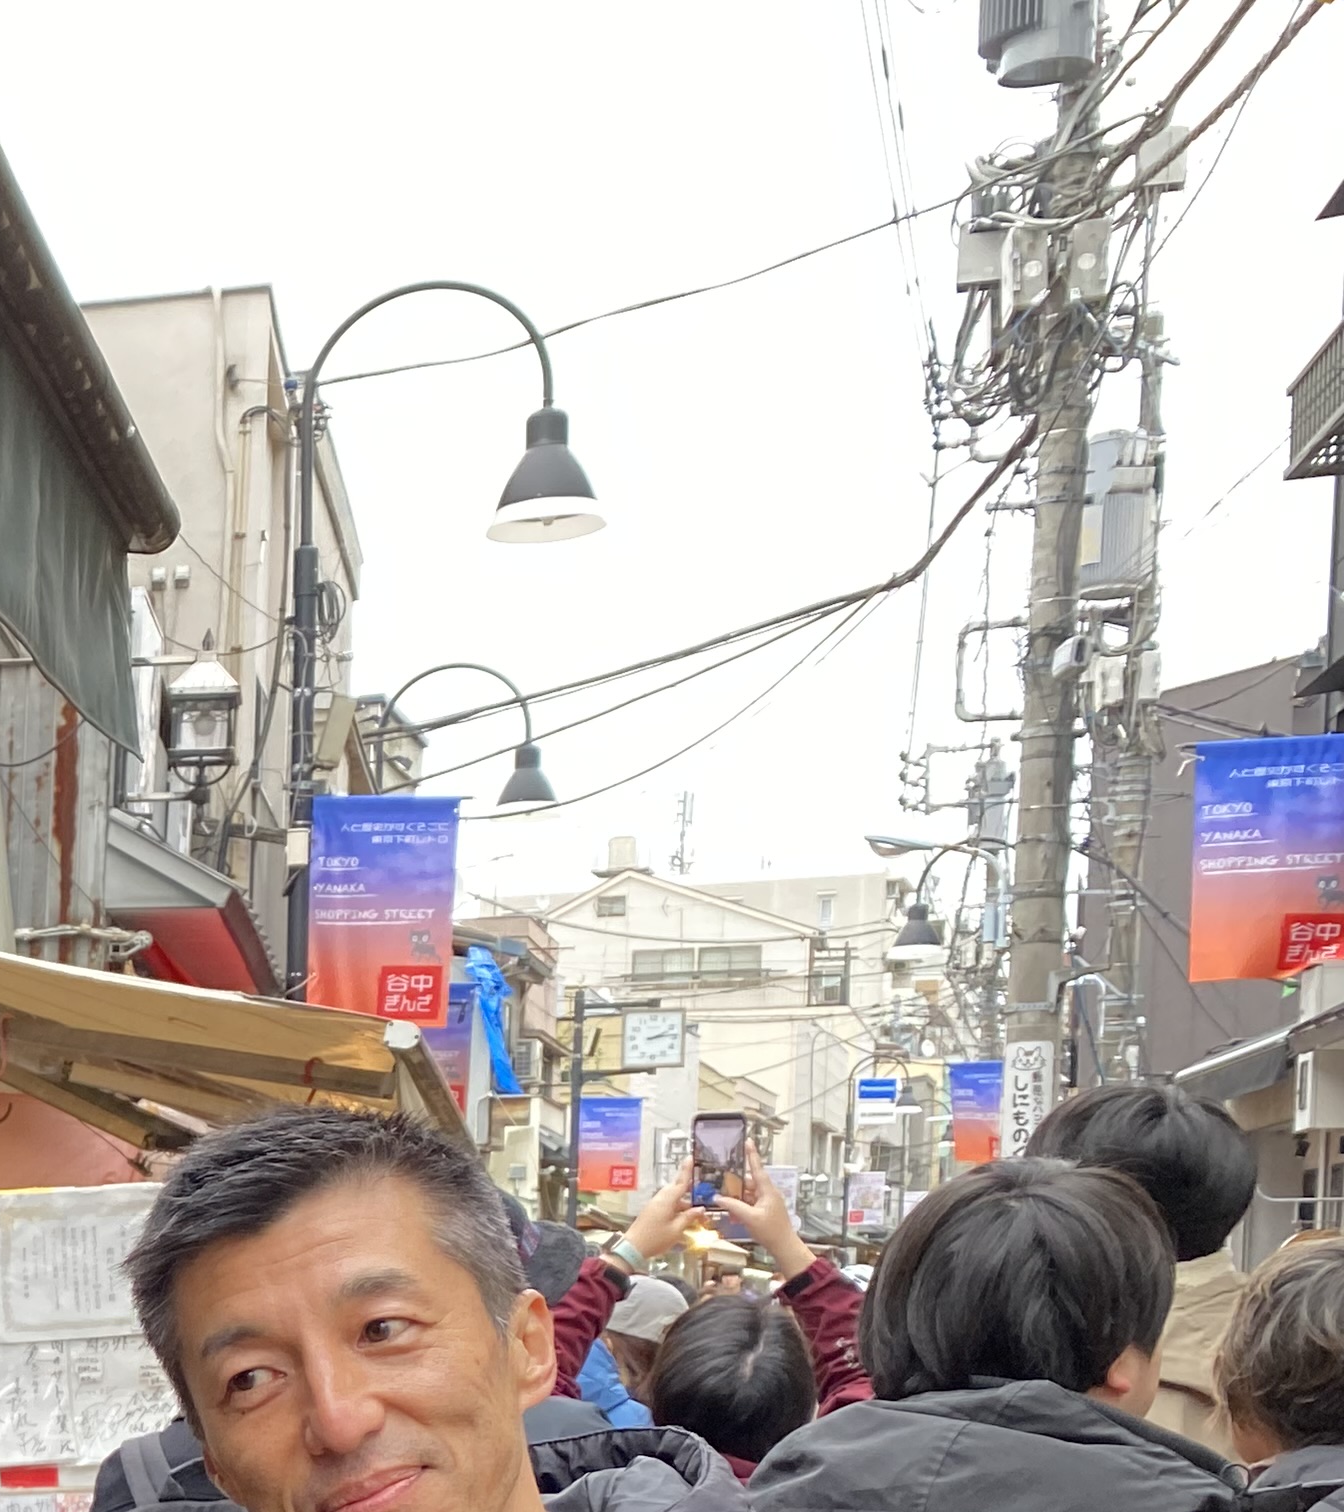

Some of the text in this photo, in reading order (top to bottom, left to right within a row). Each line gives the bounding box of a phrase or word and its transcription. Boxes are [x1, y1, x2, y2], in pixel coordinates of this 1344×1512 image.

[1201, 802, 1253, 816] TOKYO
[1201, 829, 1263, 843] YANAKA
[318, 856, 360, 868] TOKYO
[1199, 853, 1344, 871] SHOPPING STREET
[316, 883, 366, 893] YANAKA
[314, 908, 435, 920] SHOPPING STREET
[1289, 922, 1341, 942] 谷中
[1284, 943, 1338, 963] ぎんざ
[387, 974, 434, 992] 谷中
[384, 995, 433, 1012] ぎんざ
